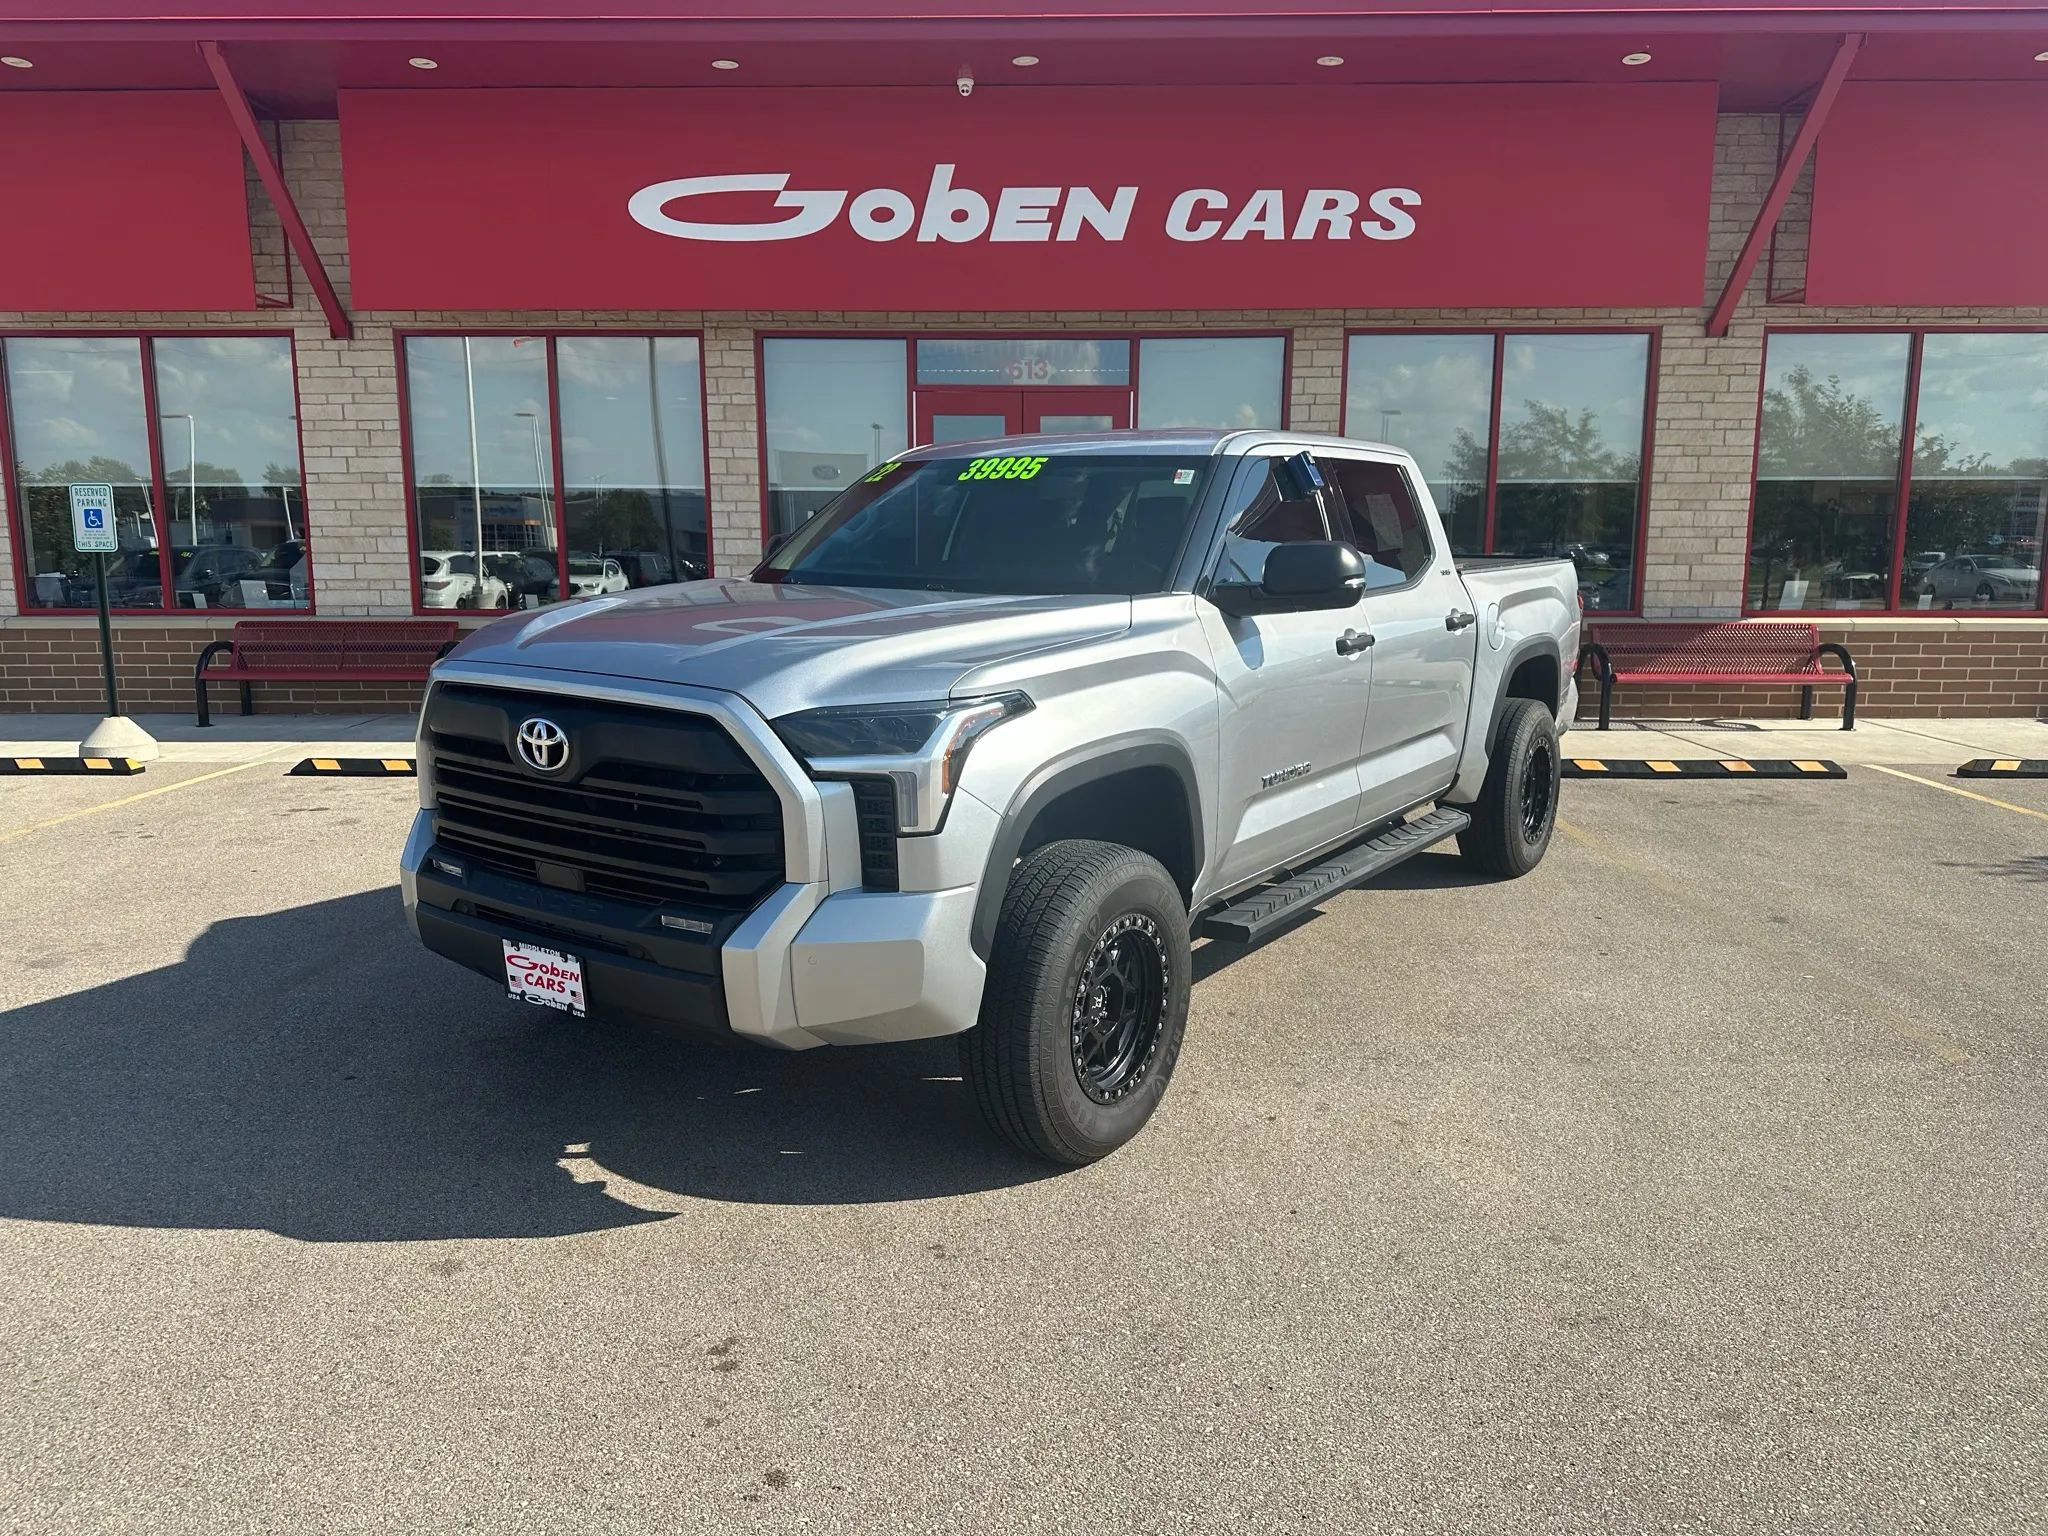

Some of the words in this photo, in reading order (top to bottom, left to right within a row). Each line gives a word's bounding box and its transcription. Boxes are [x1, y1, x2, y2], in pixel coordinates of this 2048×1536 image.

[1165, 187, 1422, 242] CARS
[1009, 361, 1049, 380] 613
[958, 457, 1048, 481] 39995
[74, 487, 108, 497] RESERVED
[77, 498, 107, 507] PARKING
[78, 540, 92, 548] THIS
[94, 540, 113, 548] SPACE
[1261, 761, 1311, 790] TUNDRA
[519, 942, 560, 957] MIDDLETON
[524, 973, 566, 993] CARS
[507, 993, 520, 1001] USA
[572, 1009, 585, 1018] USA
